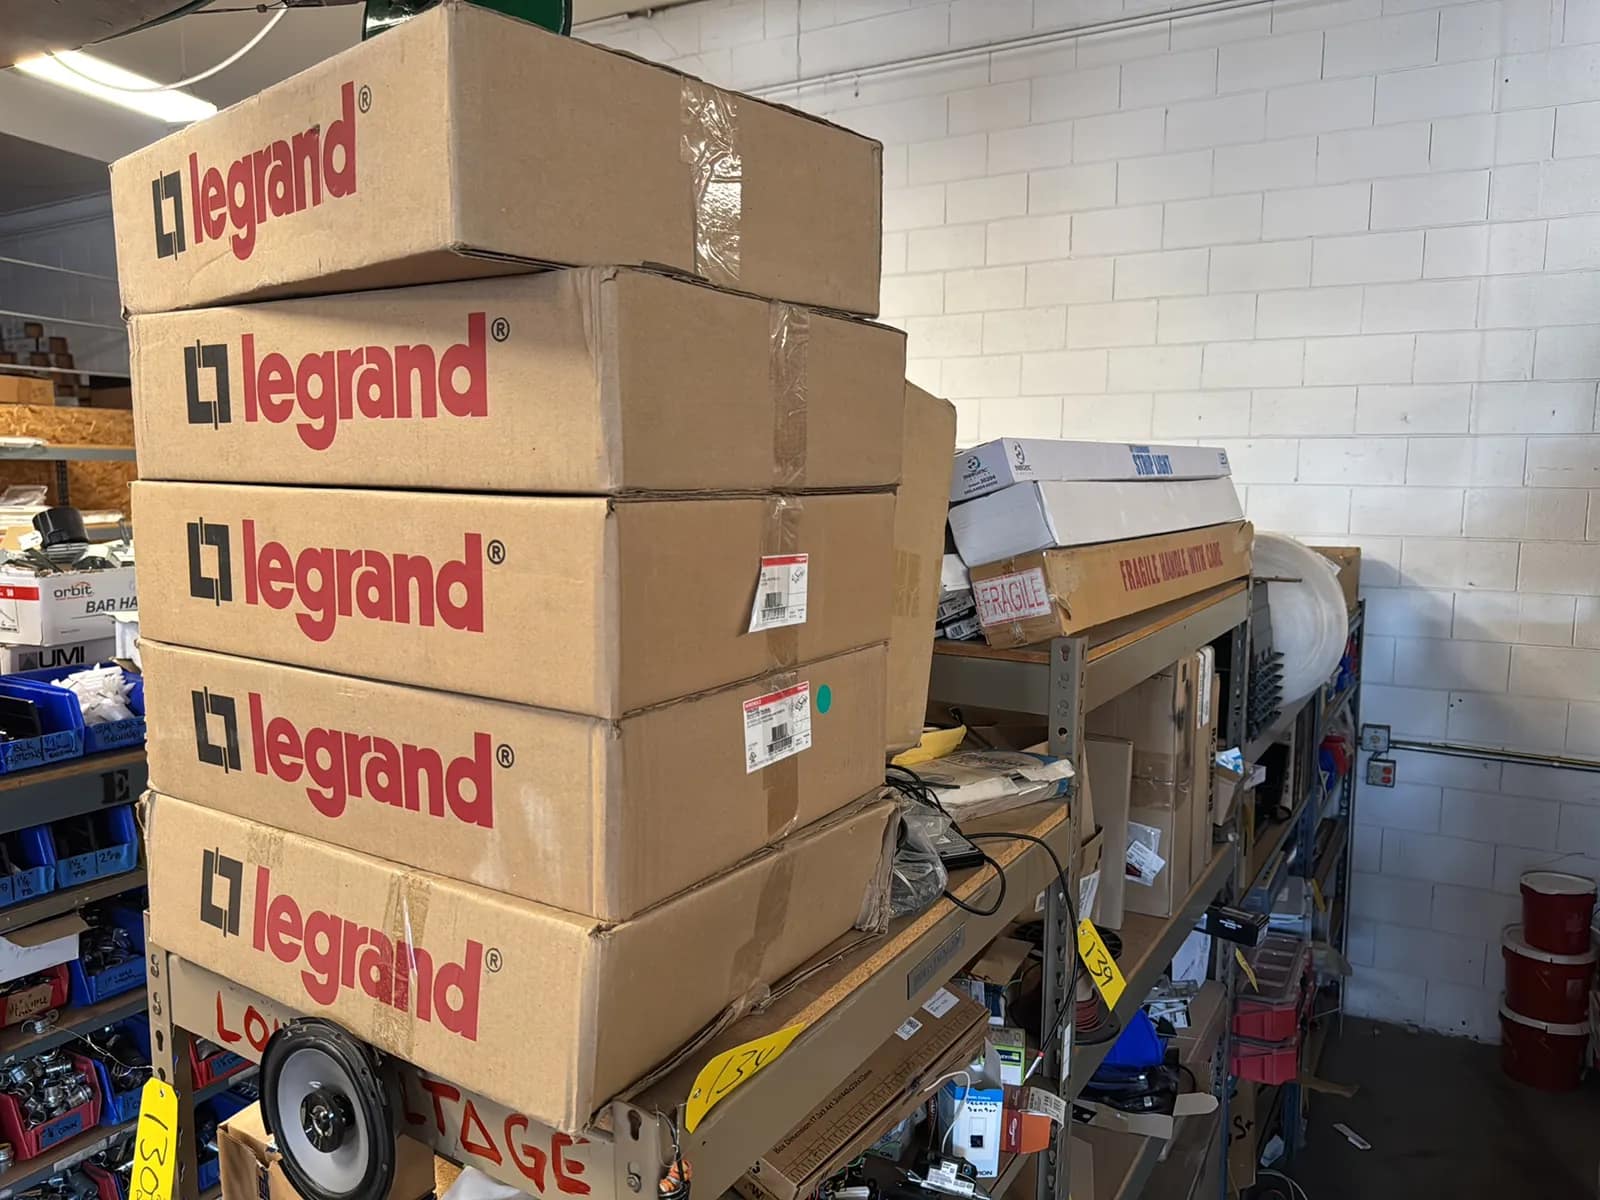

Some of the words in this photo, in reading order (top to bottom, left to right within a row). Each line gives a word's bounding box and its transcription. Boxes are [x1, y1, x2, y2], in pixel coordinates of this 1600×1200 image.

[188, 80, 357, 259] legrand
[241, 313, 488, 451] legrand
[54, 584, 93, 598] orbit
[86, 598, 116, 613] BAR
[120, 596, 138, 609] HA
[242, 518, 486, 645] legrand
[981, 575, 1045, 617] FRAGILE
[1119, 553, 1160, 592] FRAGILE
[1159, 547, 1188, 582] HANDLE
[1187, 544, 1207, 575] WITH
[1205, 541, 1223, 569] CARE
[248, 691, 495, 830] legrand
[253, 865, 484, 1042] legrand
[1085, 941, 1113, 987] 139
[216, 990, 279, 1052] LO
[400, 1073, 592, 1196] LTAGE
[140, 1113, 169, 1195] 130
